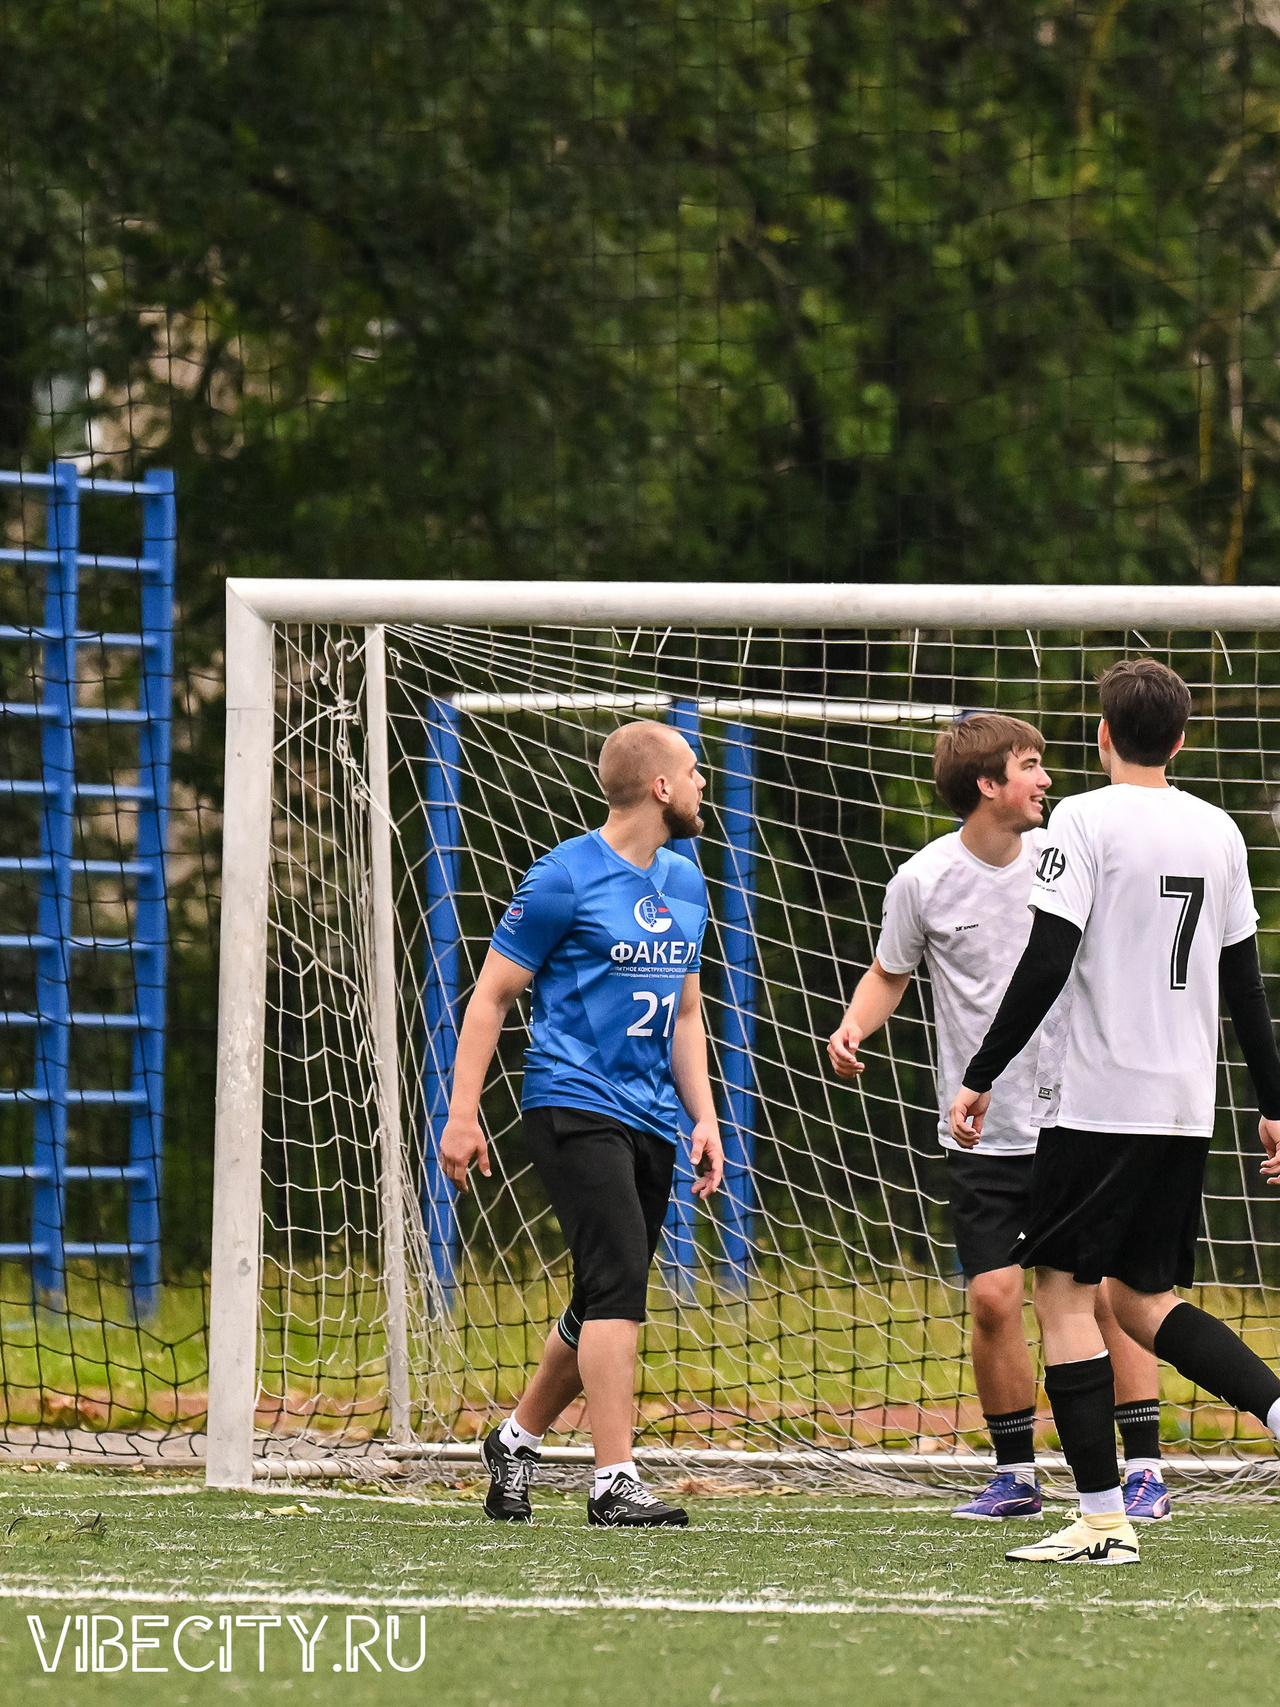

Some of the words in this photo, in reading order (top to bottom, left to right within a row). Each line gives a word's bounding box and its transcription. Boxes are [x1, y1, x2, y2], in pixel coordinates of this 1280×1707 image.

[610, 940, 697, 964] ФАКЕЛ
[1160, 875, 1205, 990] 7
[626, 991, 676, 1038] 21
